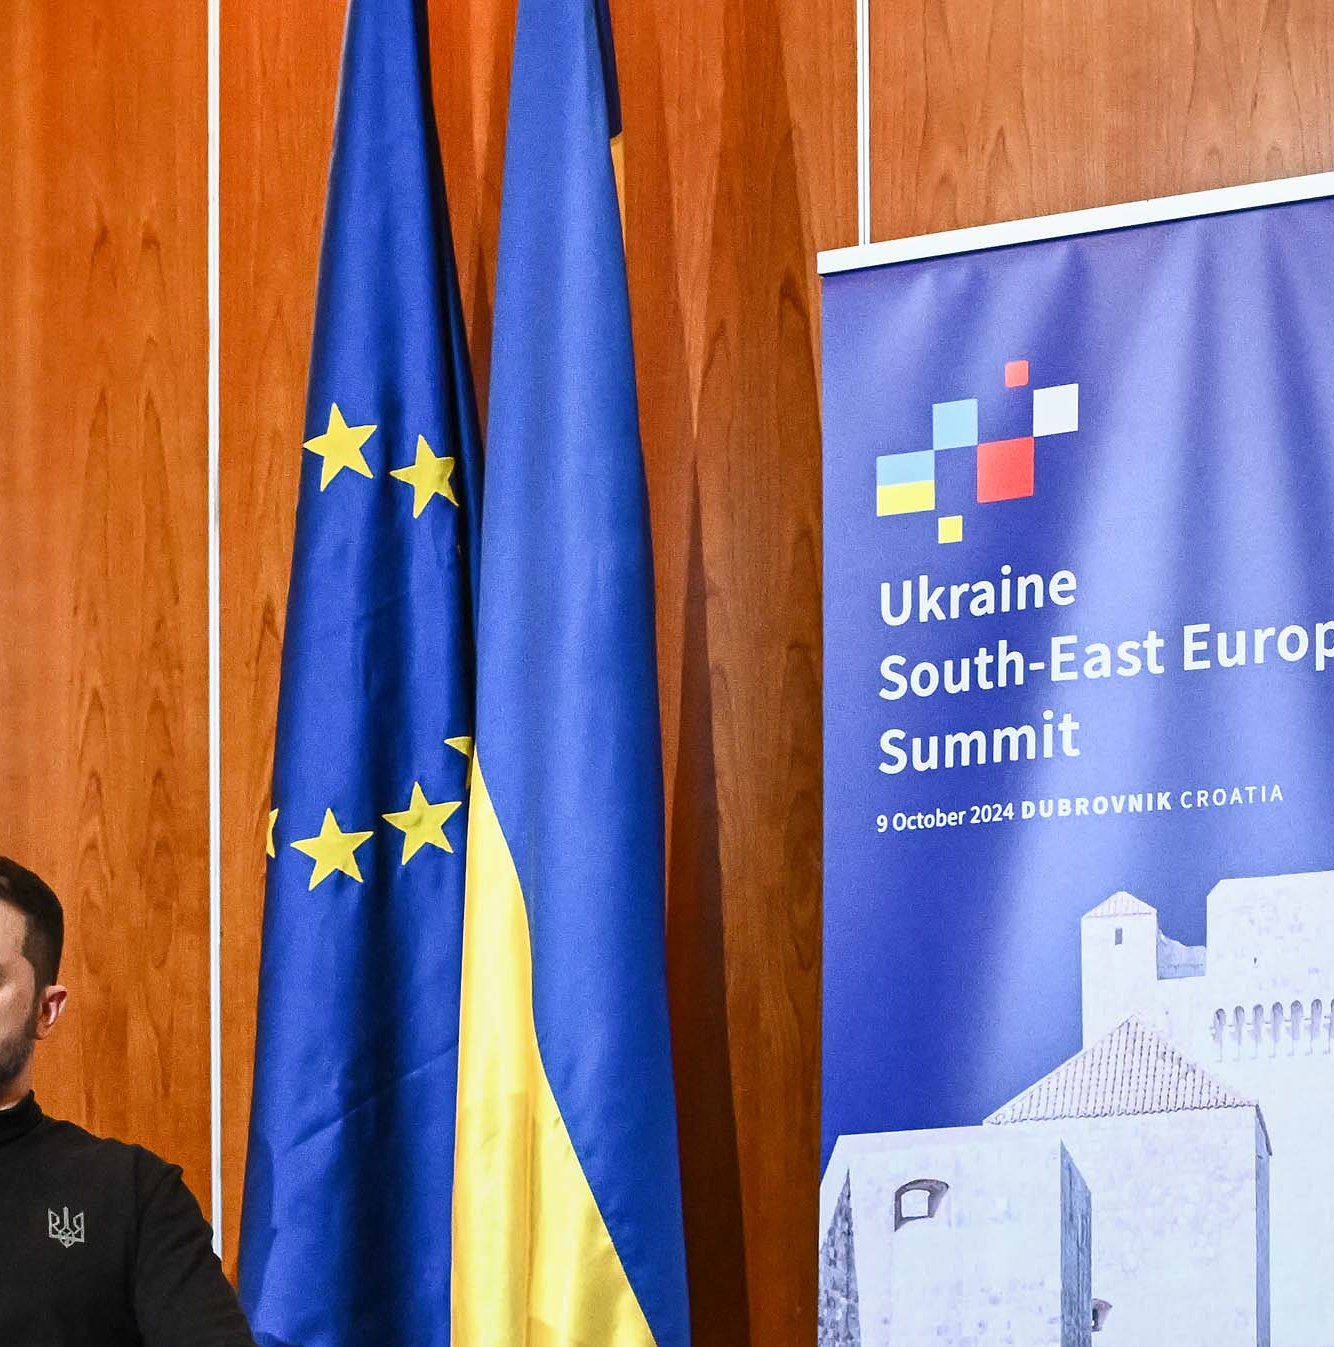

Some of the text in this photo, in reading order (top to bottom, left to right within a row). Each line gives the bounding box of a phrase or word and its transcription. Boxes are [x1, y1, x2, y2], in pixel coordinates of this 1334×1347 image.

[879, 564, 1078, 627] Ukraine
[878, 630, 1166, 701] South-East
[878, 709, 1081, 775] Summit
[876, 783, 1284, 833] 9 October 2024 DUBROVNIK CROATIA
